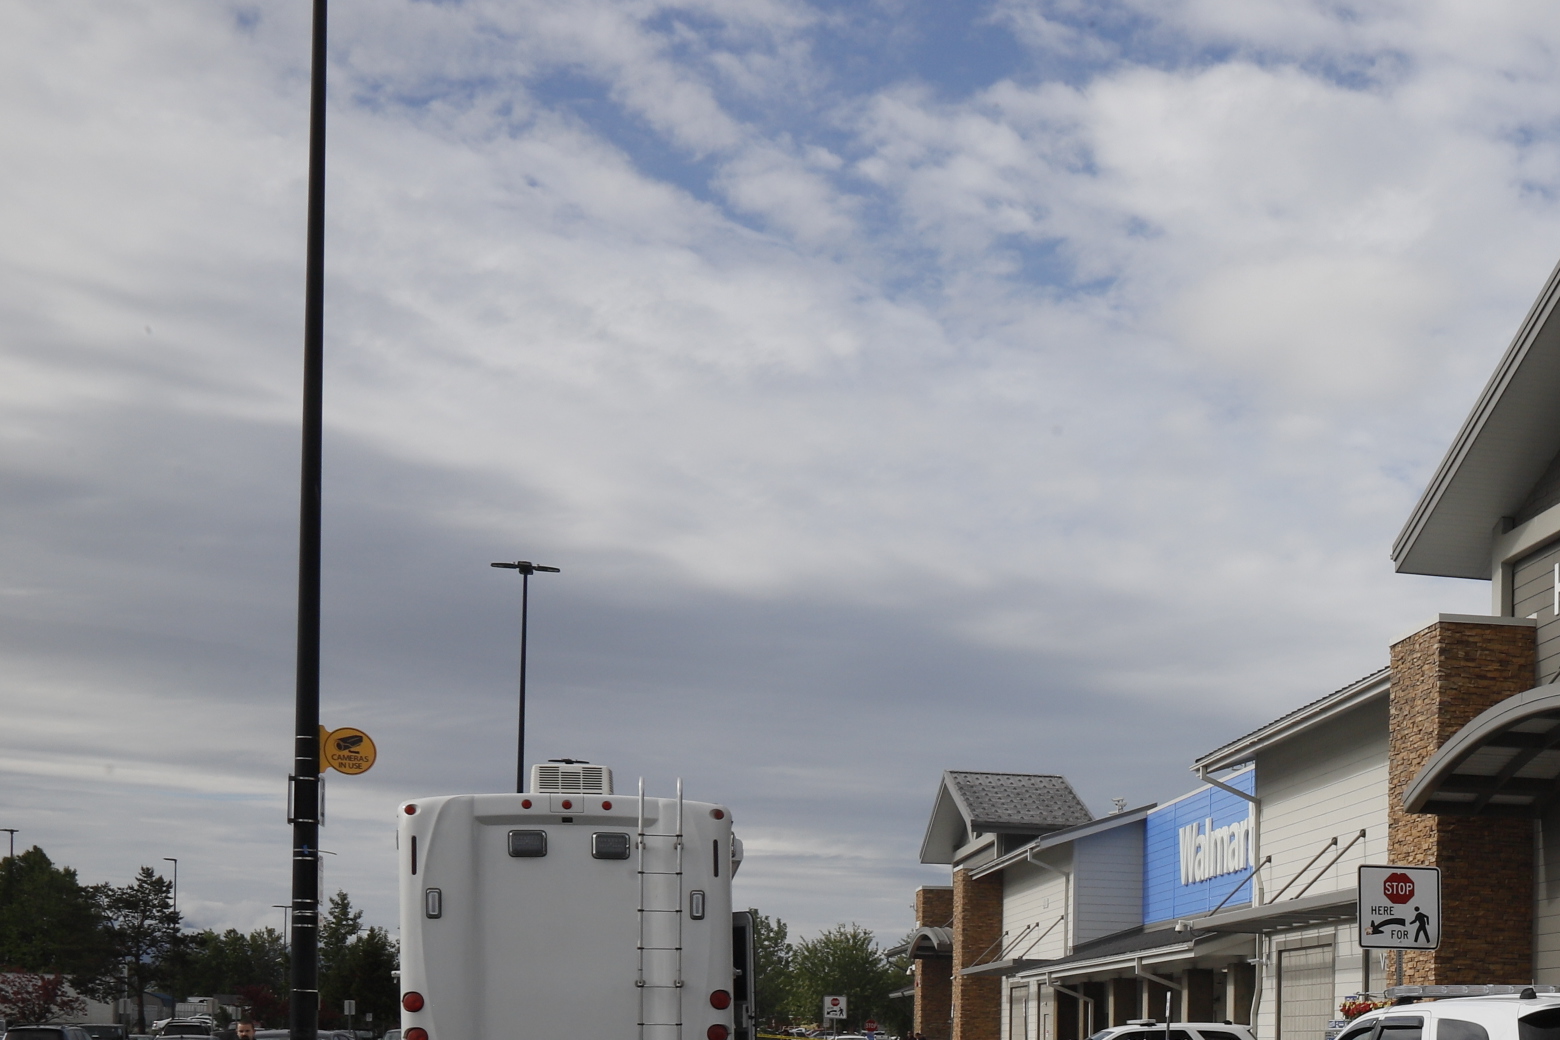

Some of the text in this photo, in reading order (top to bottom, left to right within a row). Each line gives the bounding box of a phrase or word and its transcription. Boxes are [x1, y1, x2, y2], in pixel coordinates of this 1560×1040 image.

[331, 753, 369, 762] CAMERAS
[1385, 882, 1413, 895] STOP
[1371, 905, 1395, 916] HERE
[1390, 929, 1409, 940] FOR
